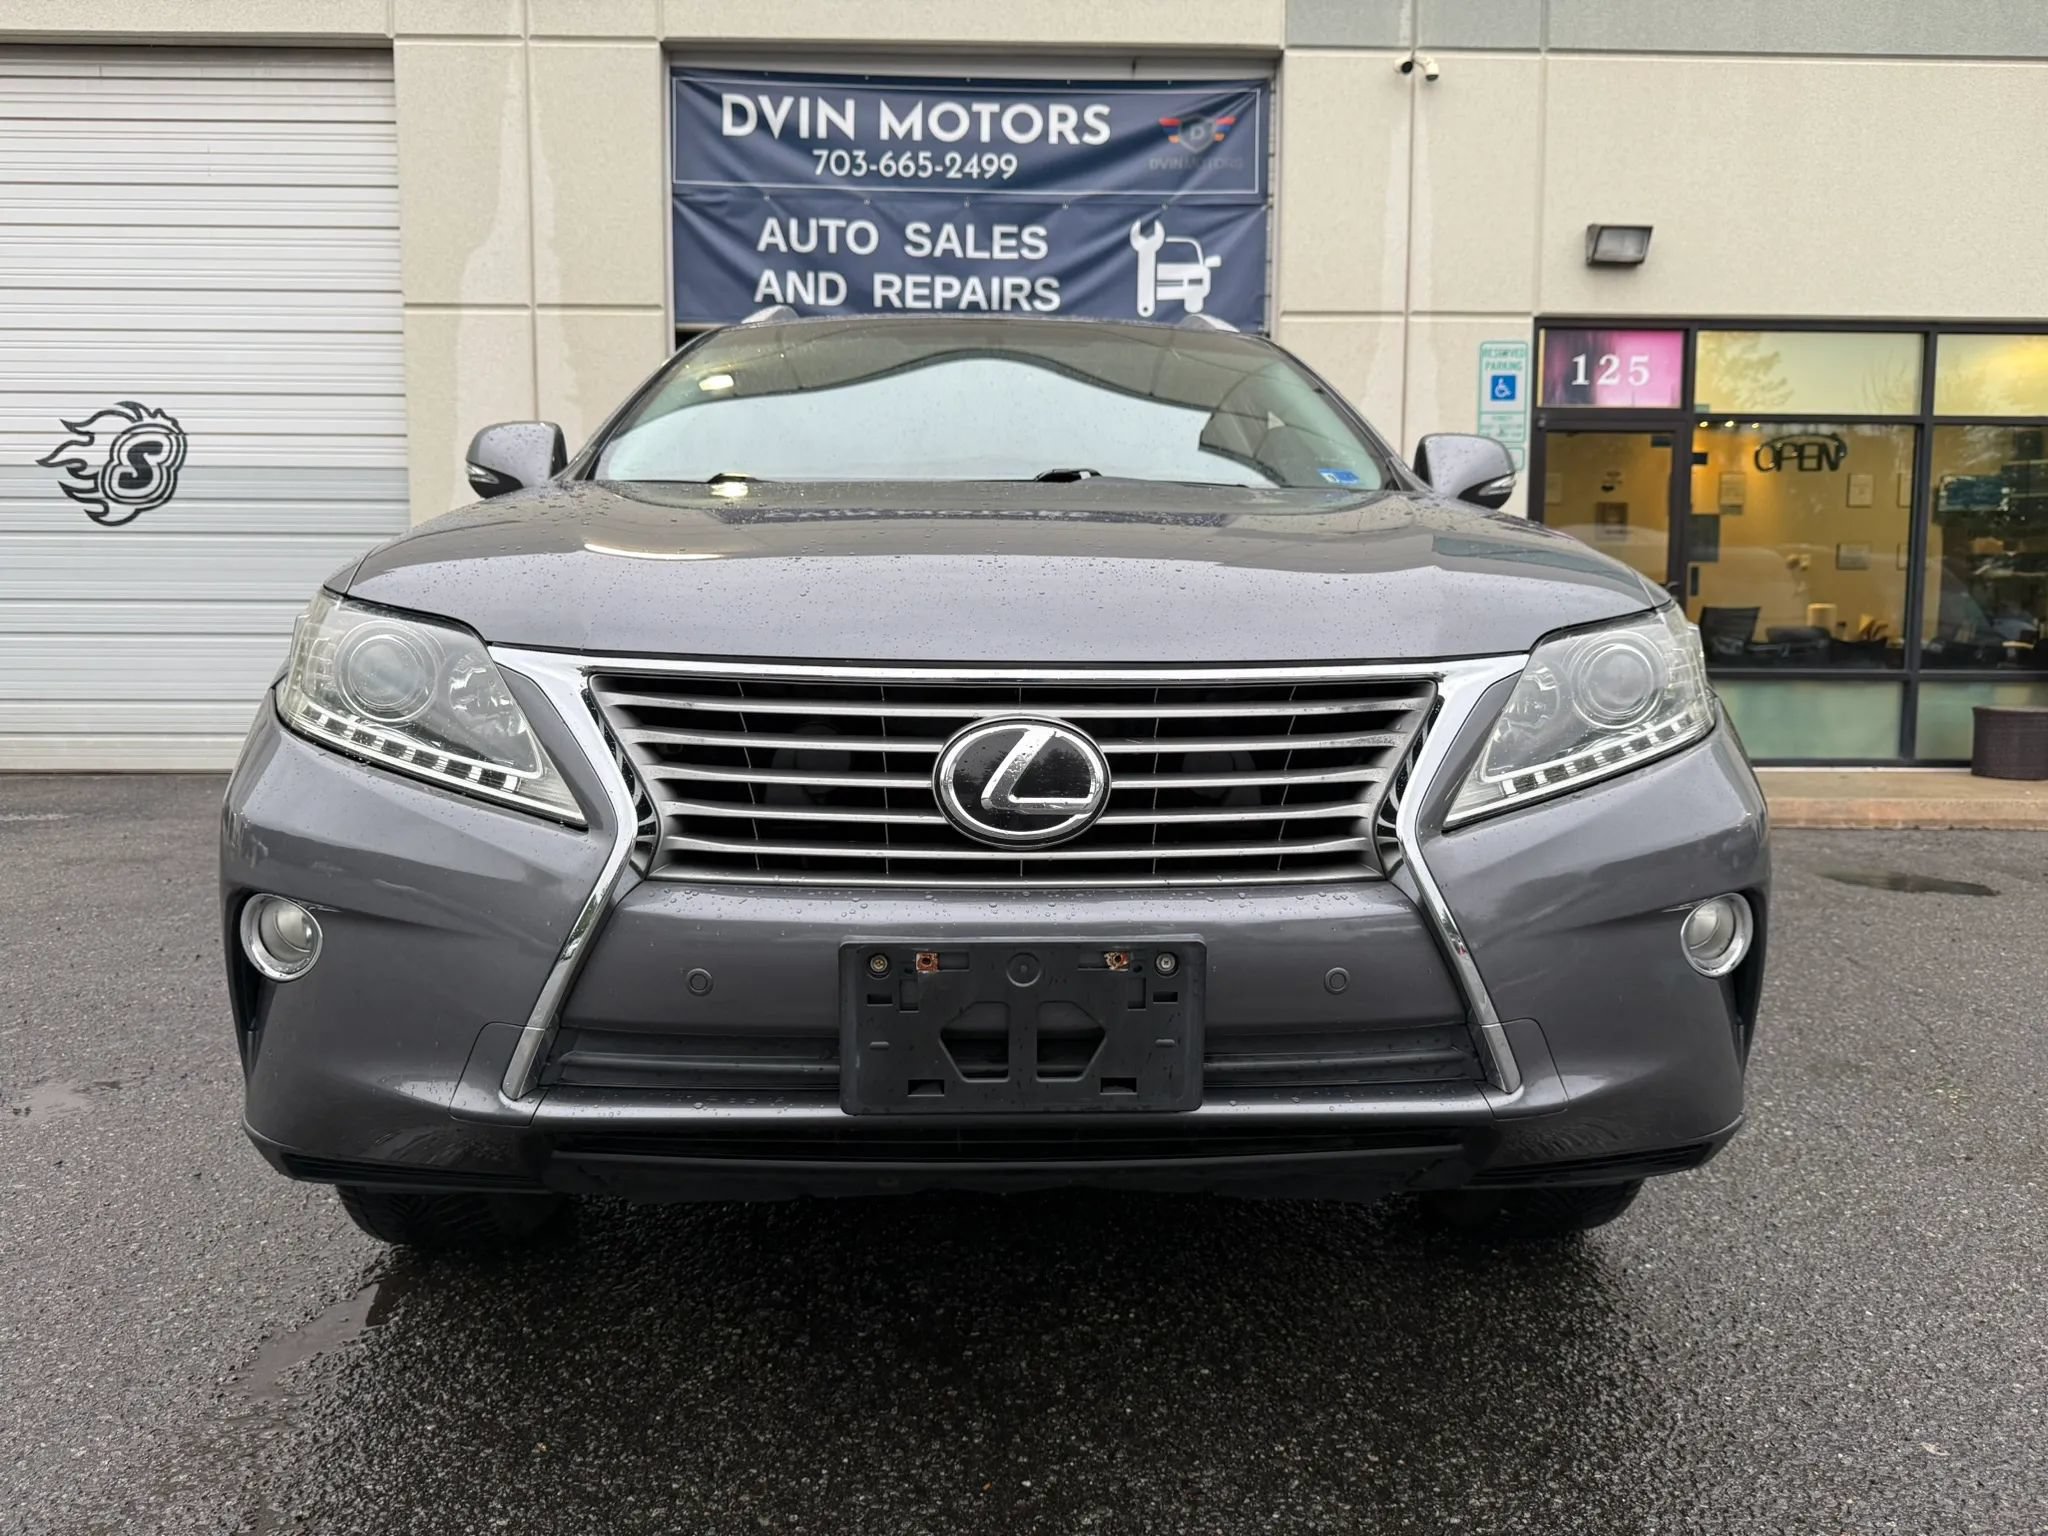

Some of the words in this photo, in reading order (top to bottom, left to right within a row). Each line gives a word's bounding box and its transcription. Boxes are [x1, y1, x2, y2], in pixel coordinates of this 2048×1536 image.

[721, 92, 856, 141] DVIN
[879, 98, 1112, 146] MOTORS
[812, 149, 1018, 180] 703-665-2499
[756, 216, 880, 255] AUTO
[904, 221, 1049, 260] SALES
[753, 269, 848, 306] AND
[872, 272, 1062, 312] REPAIRS
[1570, 353, 1650, 386] 125
[1754, 442, 1841, 472] OPEN
